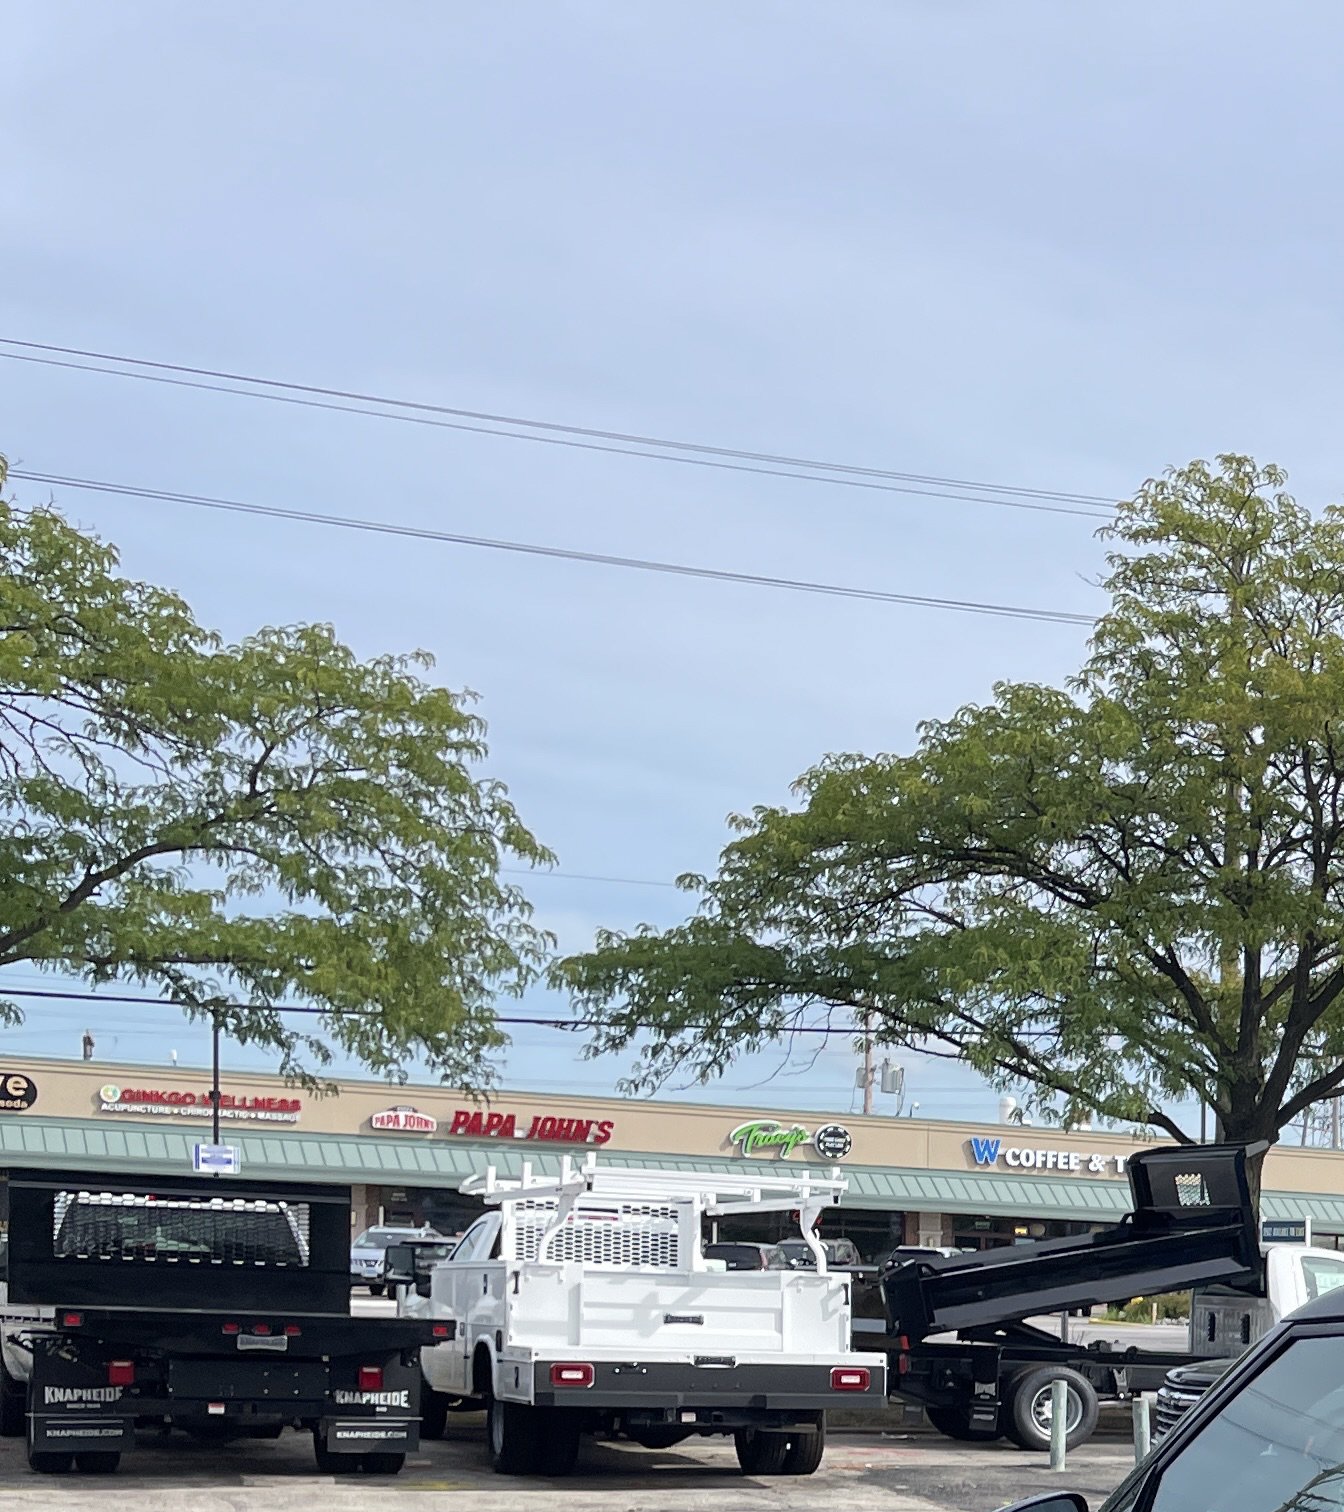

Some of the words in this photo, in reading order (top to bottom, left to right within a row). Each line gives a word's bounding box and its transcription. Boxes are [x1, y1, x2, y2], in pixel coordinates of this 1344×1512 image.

[450, 1110, 516, 1137] PAPA
[526, 1116, 615, 1144] JOHN'S
[1006, 1148, 1080, 1171] COFFEE
[1088, 1154, 1105, 1171] &
[45, 1386, 123, 1404] KNAPHEIDE
[335, 1390, 411, 1408] KNAPHEIDE
